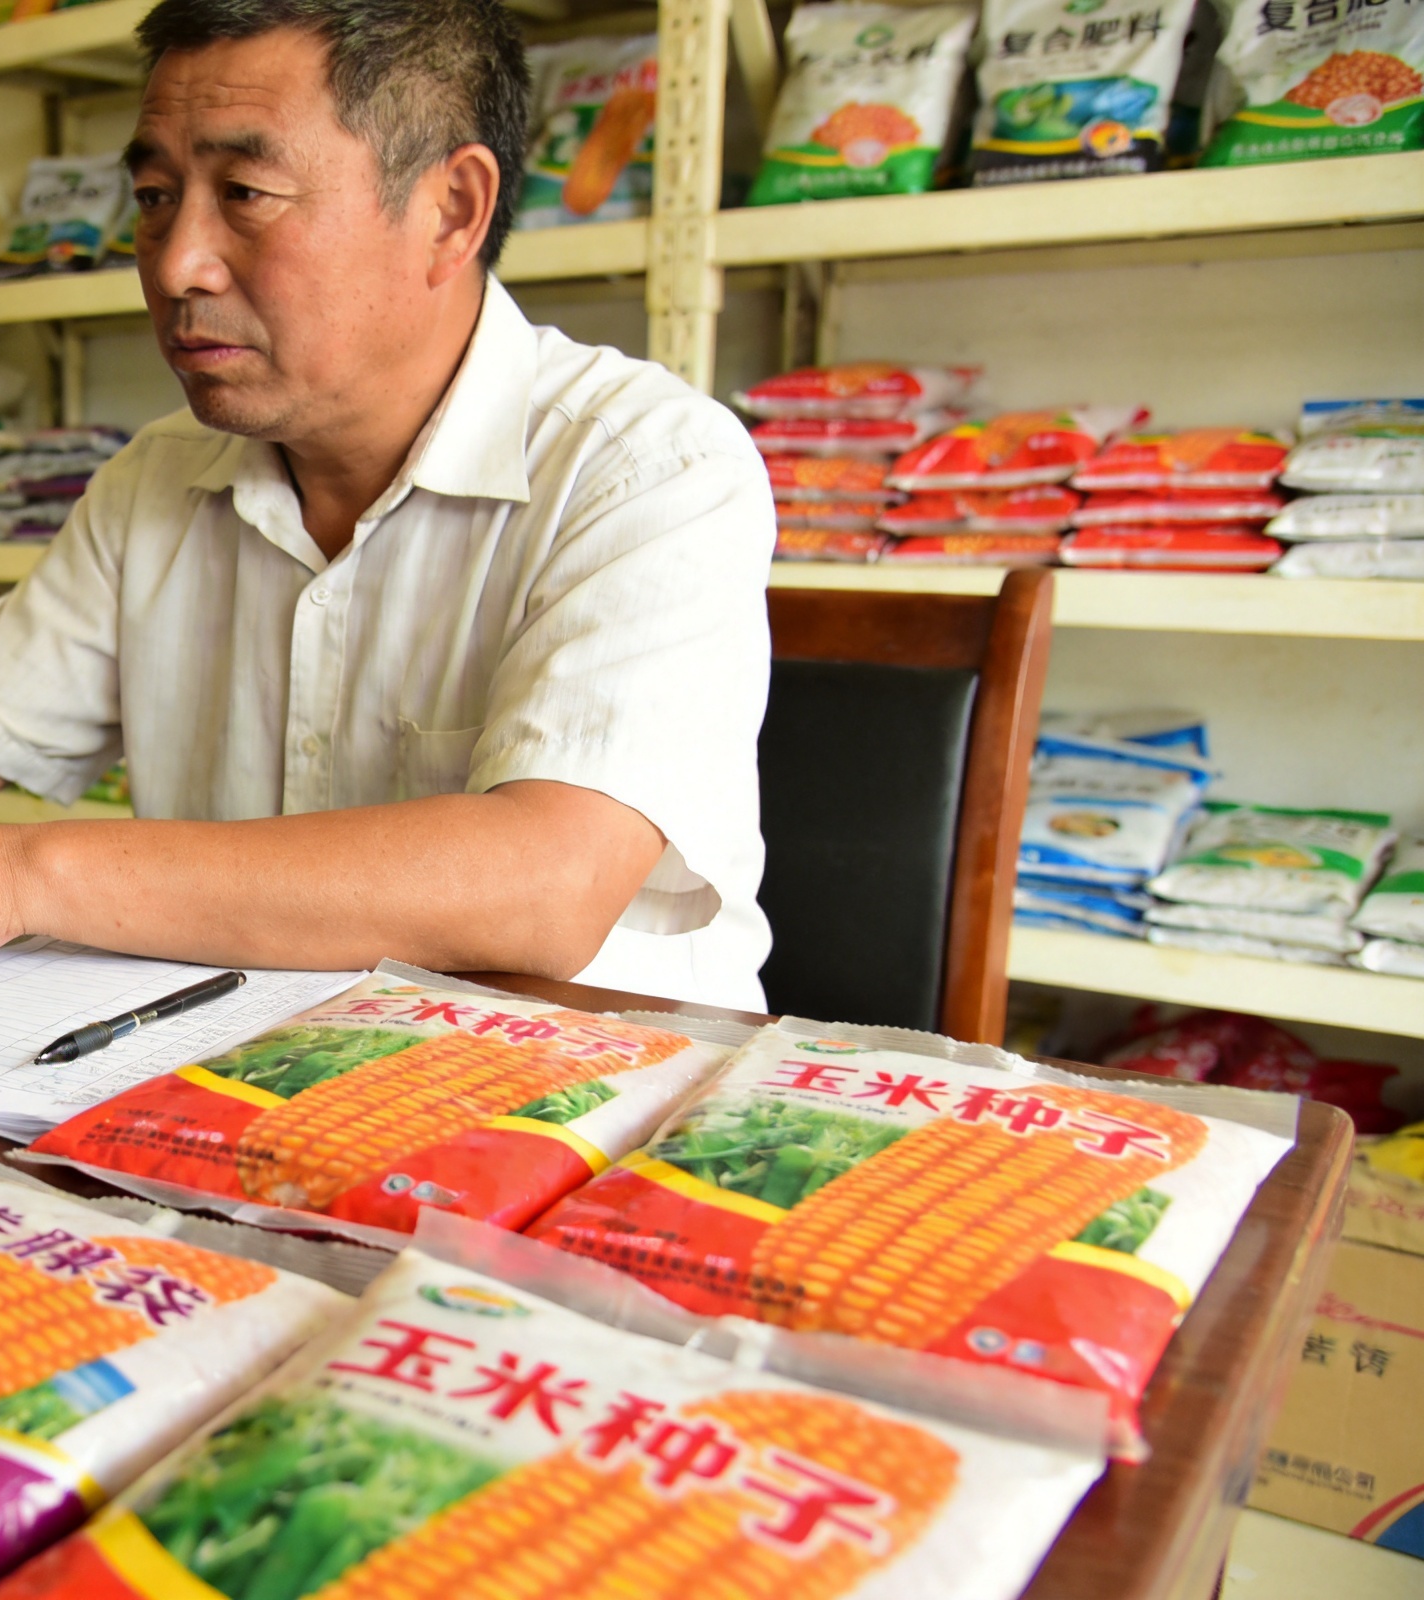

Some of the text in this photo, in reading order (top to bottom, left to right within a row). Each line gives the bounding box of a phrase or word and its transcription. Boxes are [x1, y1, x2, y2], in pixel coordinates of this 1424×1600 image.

[1003, 8, 1164, 56] 复合肥料
[761, 1059, 1170, 1160] 玉米种子
[326, 1320, 882, 1547] 玉米种子
